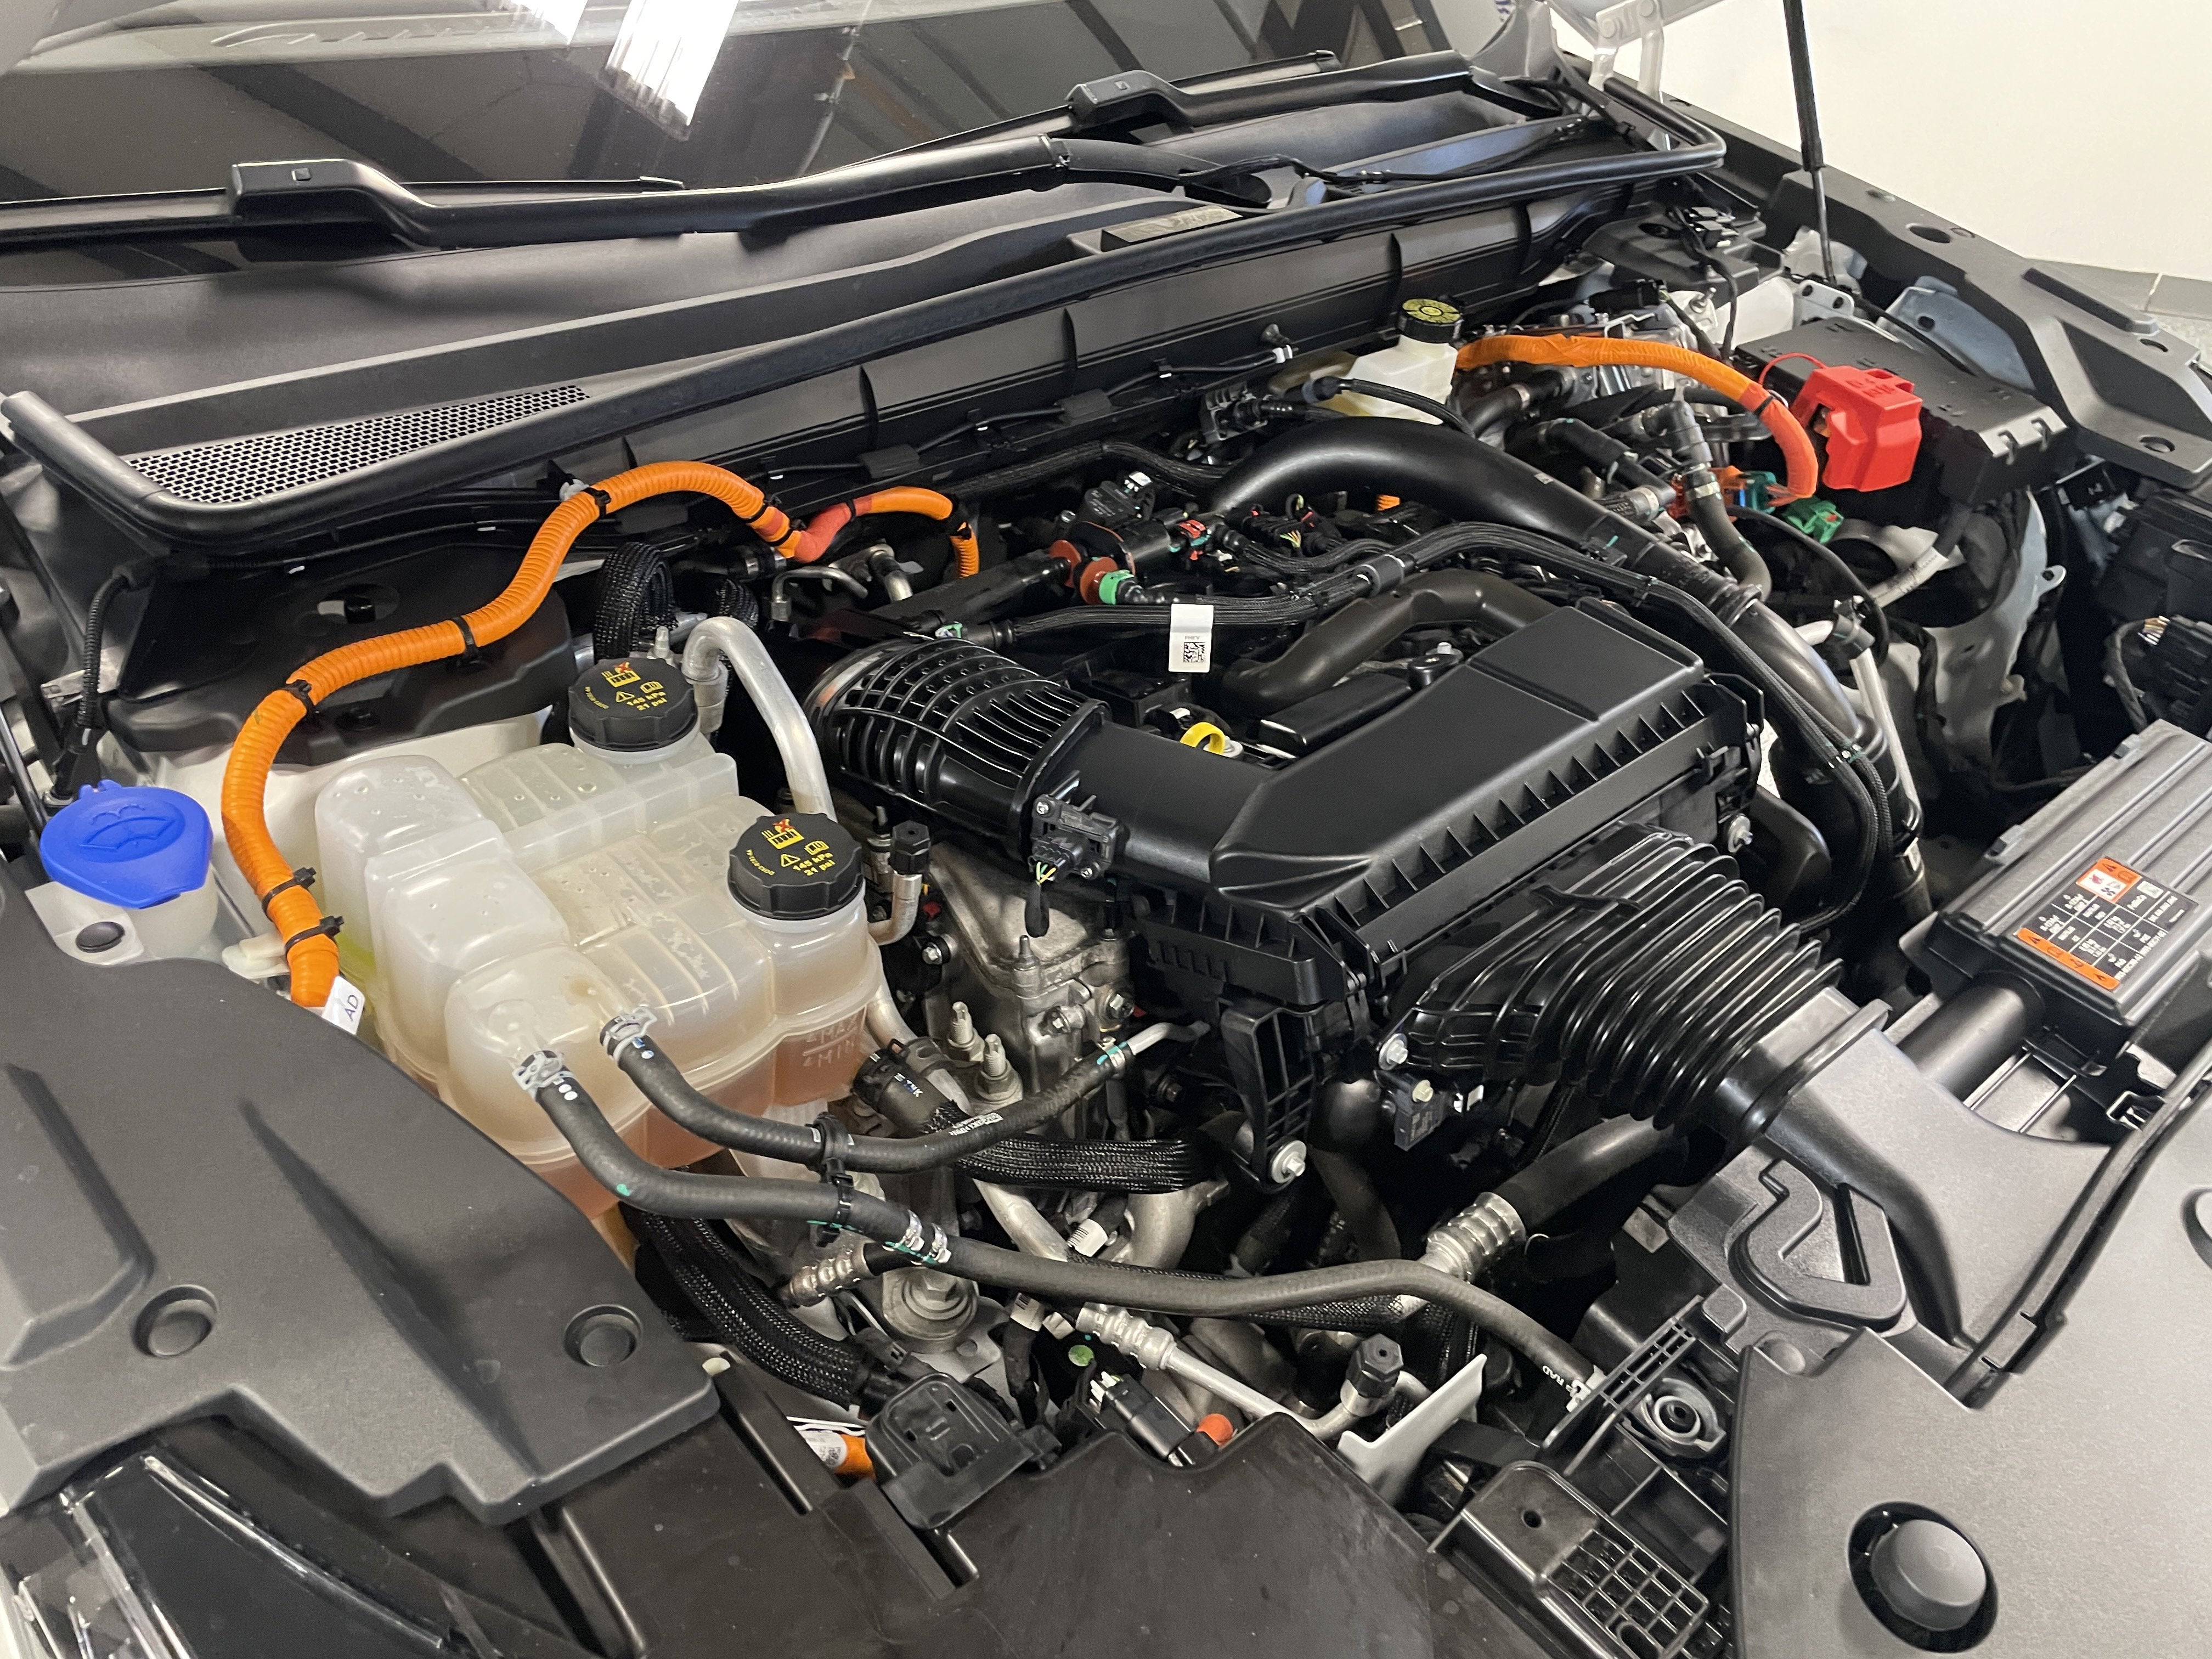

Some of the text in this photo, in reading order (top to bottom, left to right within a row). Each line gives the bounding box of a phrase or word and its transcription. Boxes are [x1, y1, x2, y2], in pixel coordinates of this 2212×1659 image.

[627, 691, 666, 706] 145 kPa
[651, 697, 667, 707] psi
[793, 853, 833, 871] 145 kPa
[804, 859, 836, 876] 21 psi
[345, 995, 359, 1022] AD
[1542, 1365, 1565, 1386] RAD
